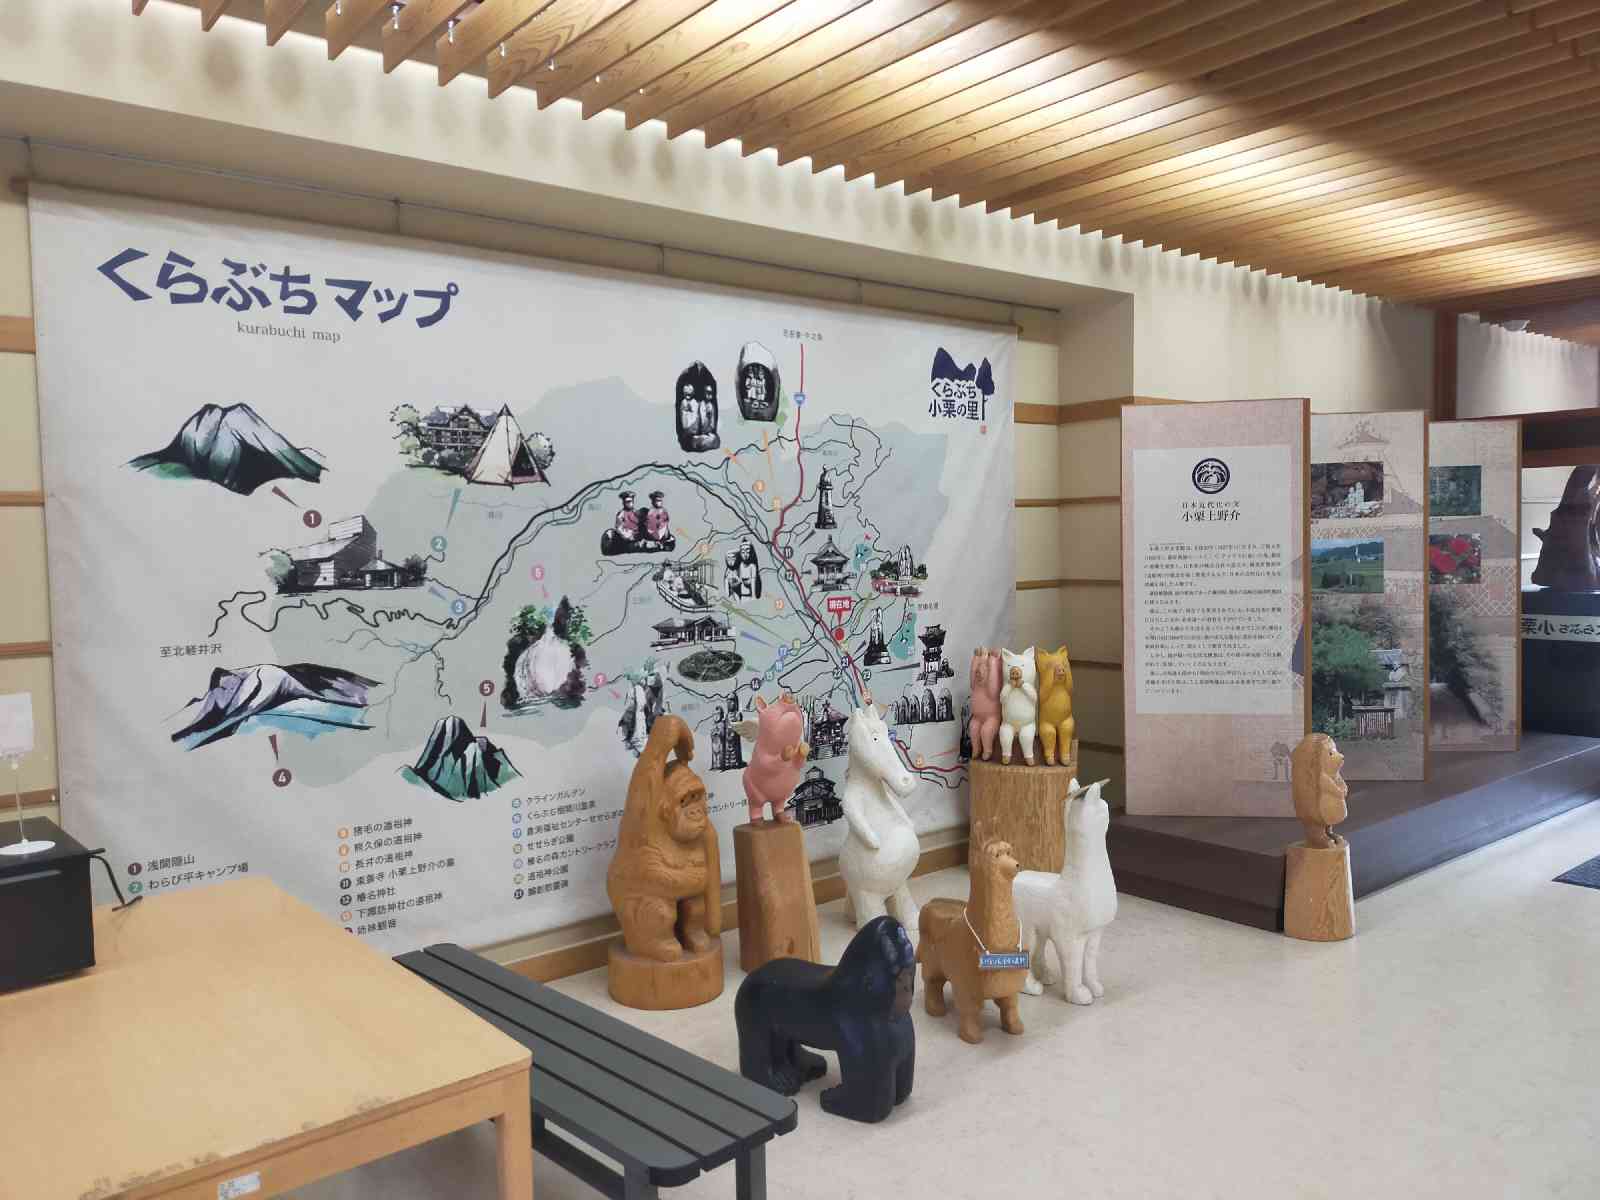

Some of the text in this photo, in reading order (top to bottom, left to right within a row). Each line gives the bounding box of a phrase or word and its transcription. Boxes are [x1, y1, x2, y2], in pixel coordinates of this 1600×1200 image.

[97, 247, 459, 328] くらぶちマップ
[236, 320, 341, 344] kurabuchi map
[931, 382, 977, 399] くらぶち
[928, 399, 979, 420] 小栗の里
[1182, 510, 1240, 522] 小栗上野介
